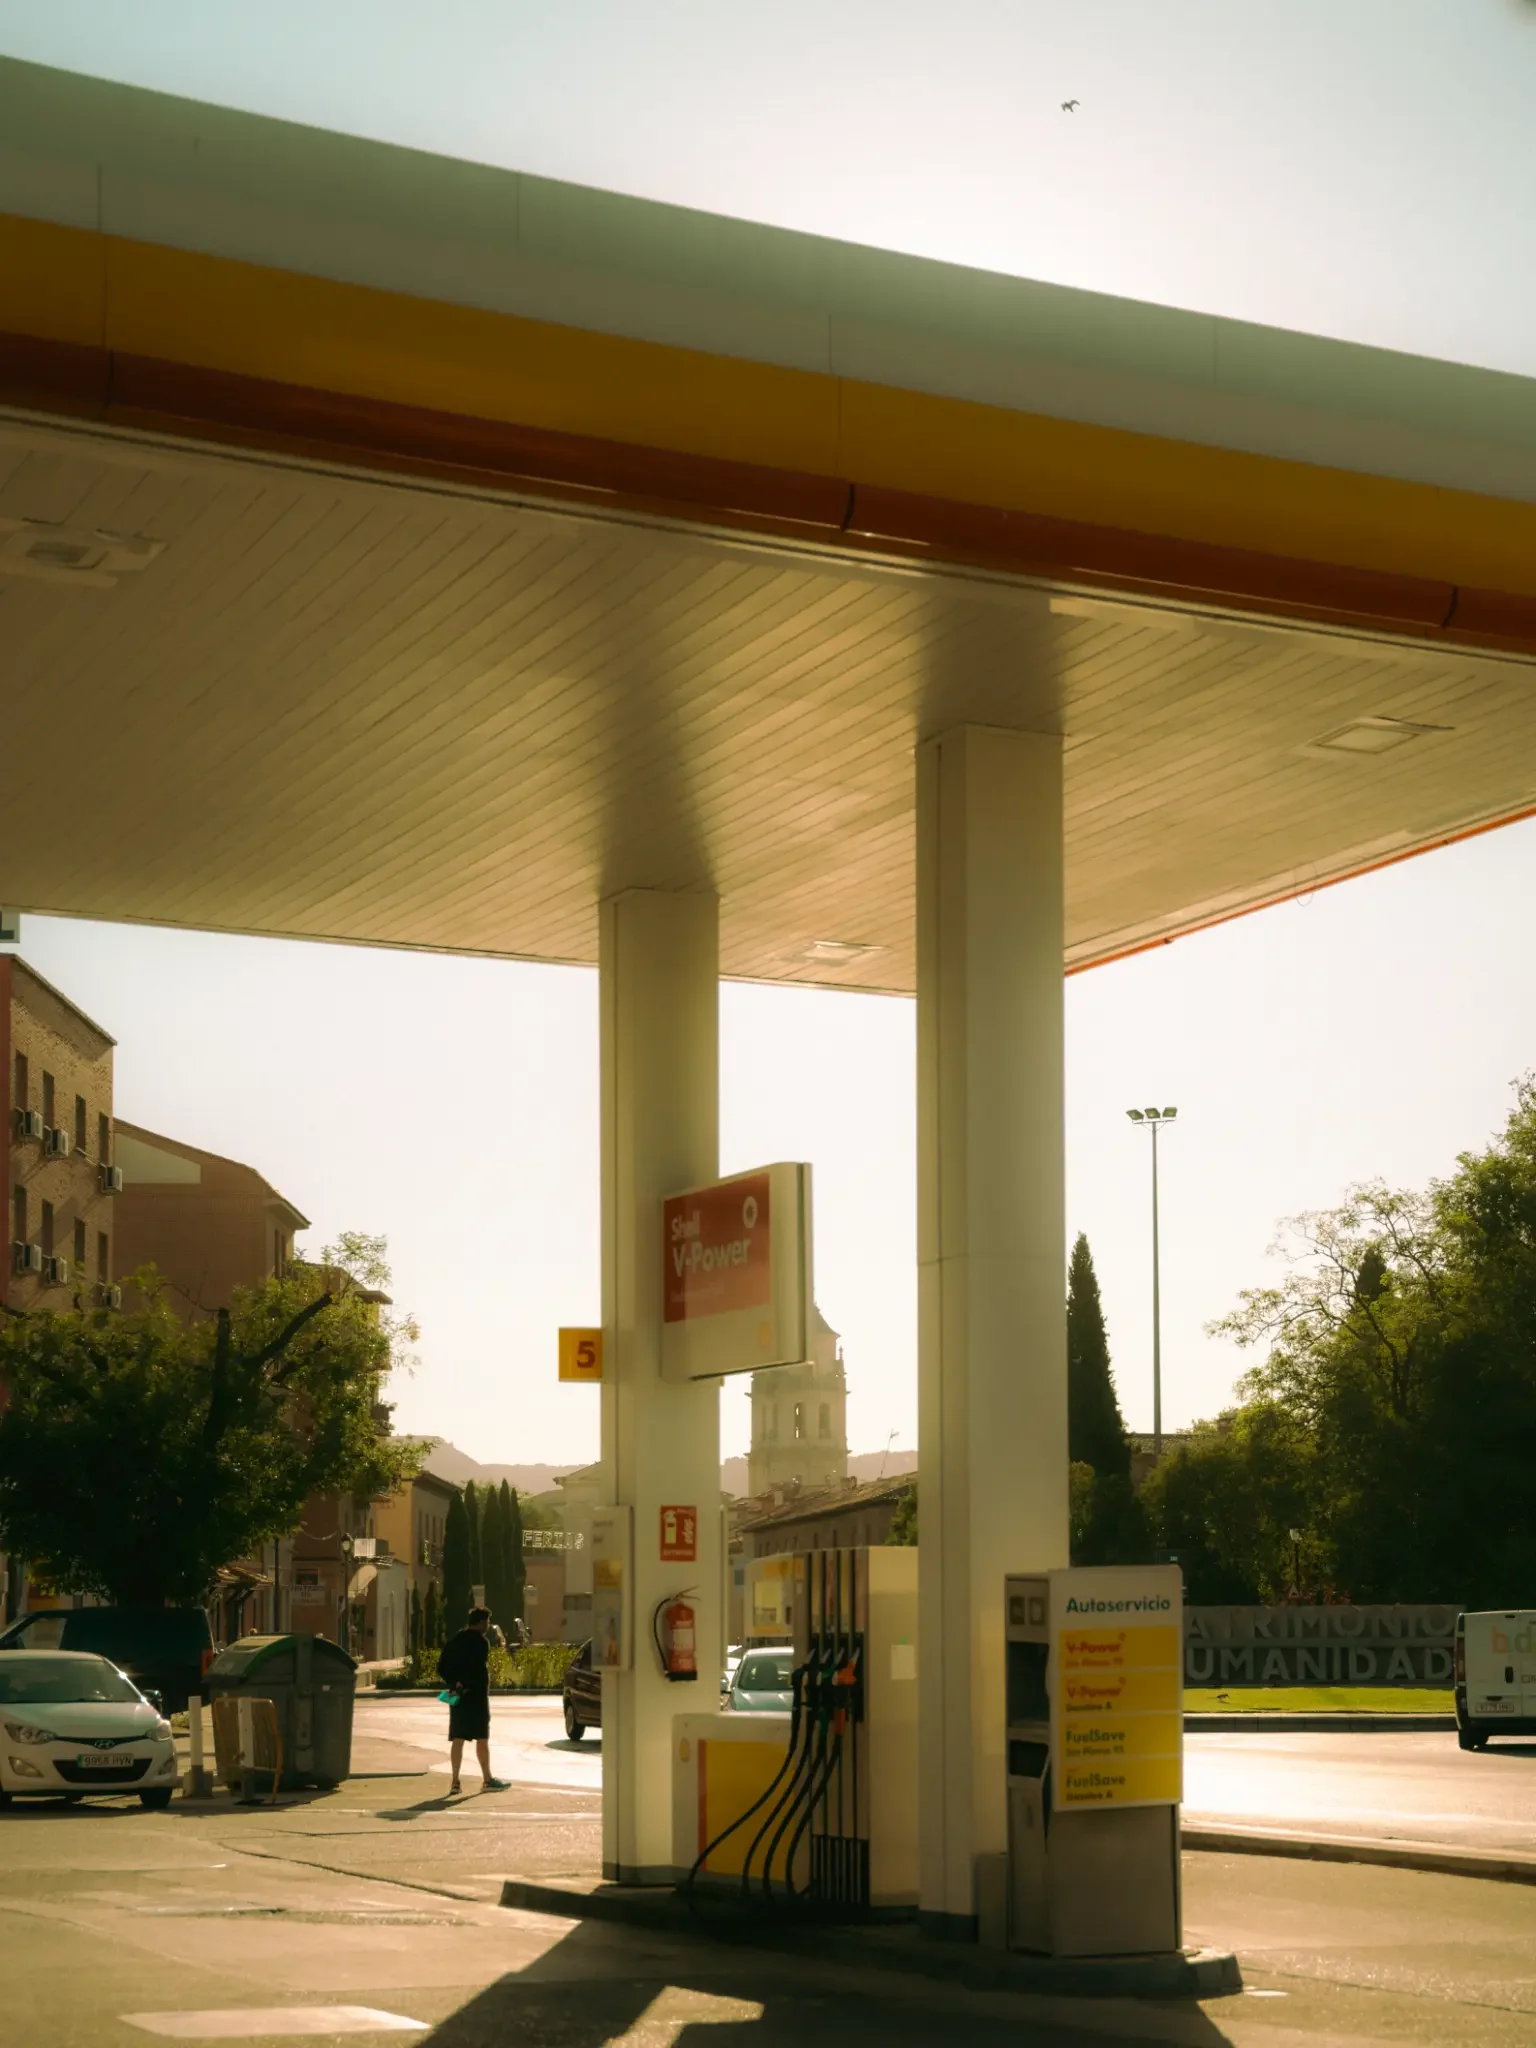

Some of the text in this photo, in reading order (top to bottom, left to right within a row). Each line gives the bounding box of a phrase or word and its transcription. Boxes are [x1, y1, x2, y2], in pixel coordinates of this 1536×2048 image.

[671, 1209, 701, 1241] Shell
[672, 1237, 752, 1277] V-Power
[576, 1340, 597, 1369] 5
[1066, 1594, 1171, 1614] Autoservicio
[1066, 1728, 1126, 1743] FuelSave
[1066, 1772, 1126, 1788] FuelSave
